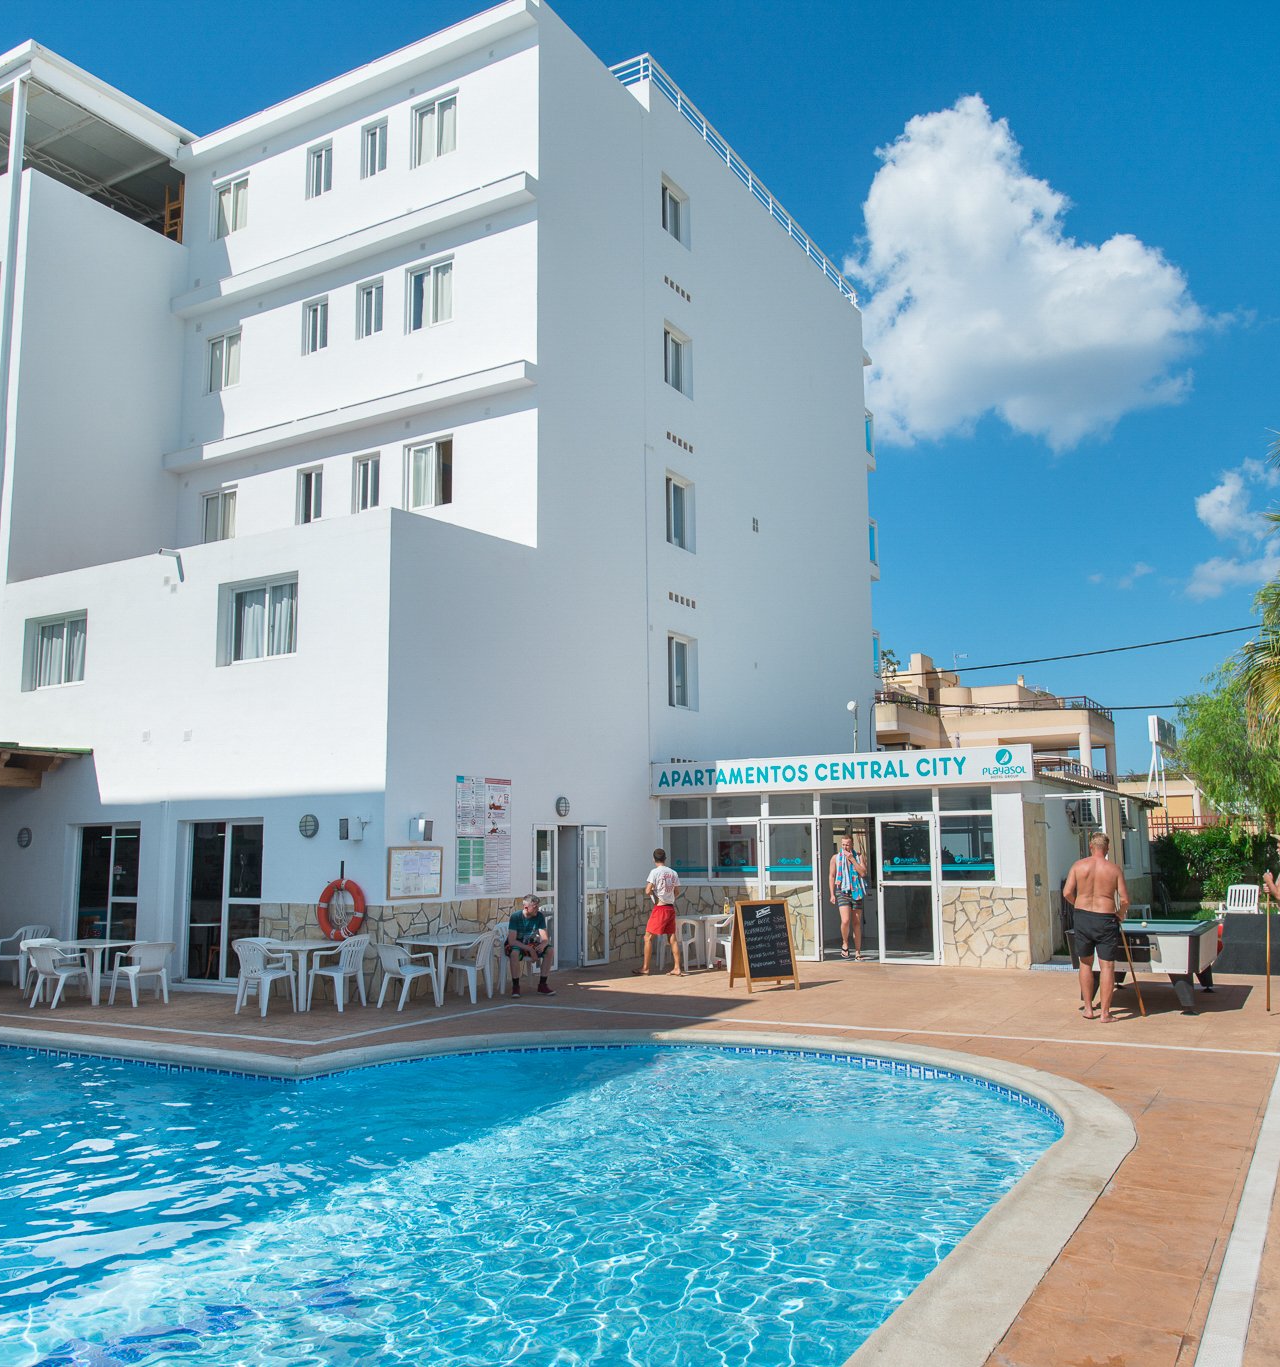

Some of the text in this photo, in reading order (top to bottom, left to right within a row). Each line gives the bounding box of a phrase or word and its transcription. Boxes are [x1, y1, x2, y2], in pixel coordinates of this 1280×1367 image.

[658, 756, 967, 787] APARTAMENTOS CENTRAL CITY
